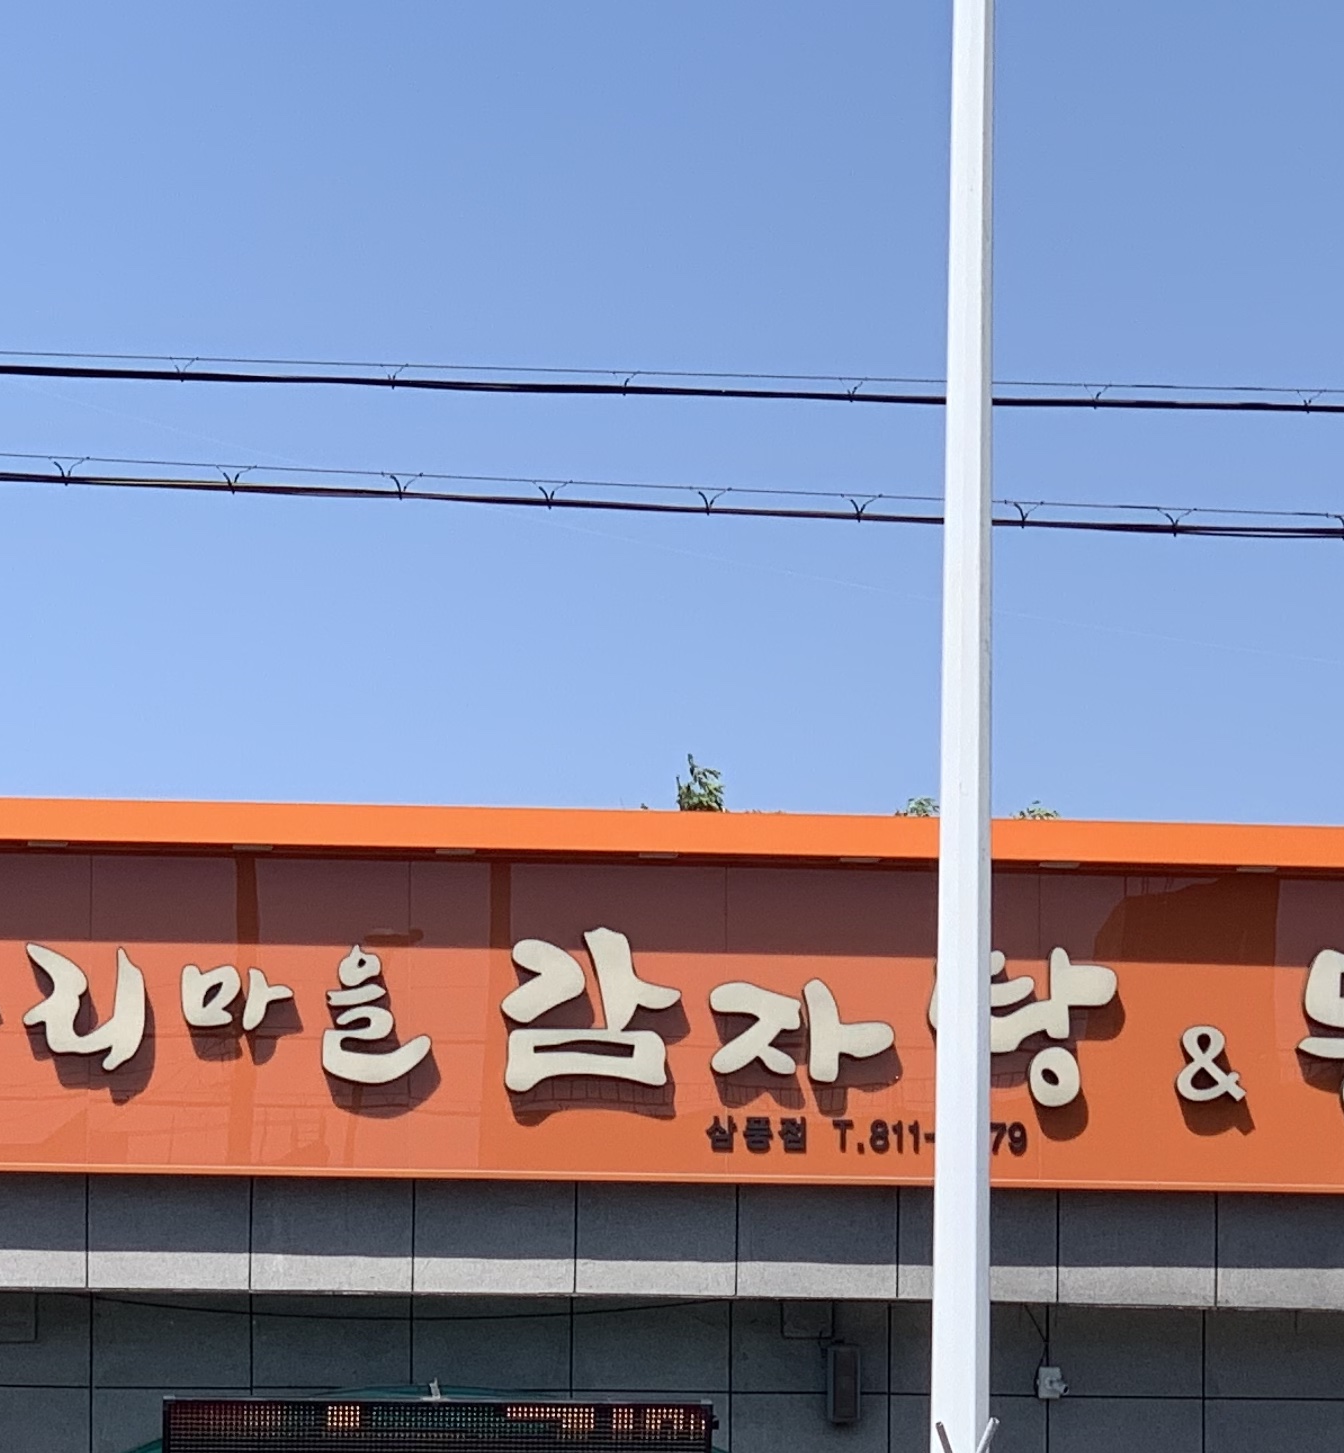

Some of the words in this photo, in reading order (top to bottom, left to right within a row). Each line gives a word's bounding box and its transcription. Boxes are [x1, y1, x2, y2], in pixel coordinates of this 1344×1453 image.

[500, 926, 1118, 1108] 감자탕
[1176, 1024, 1248, 1102] &
[832, 1119, 1029, 1156] T.811-79
